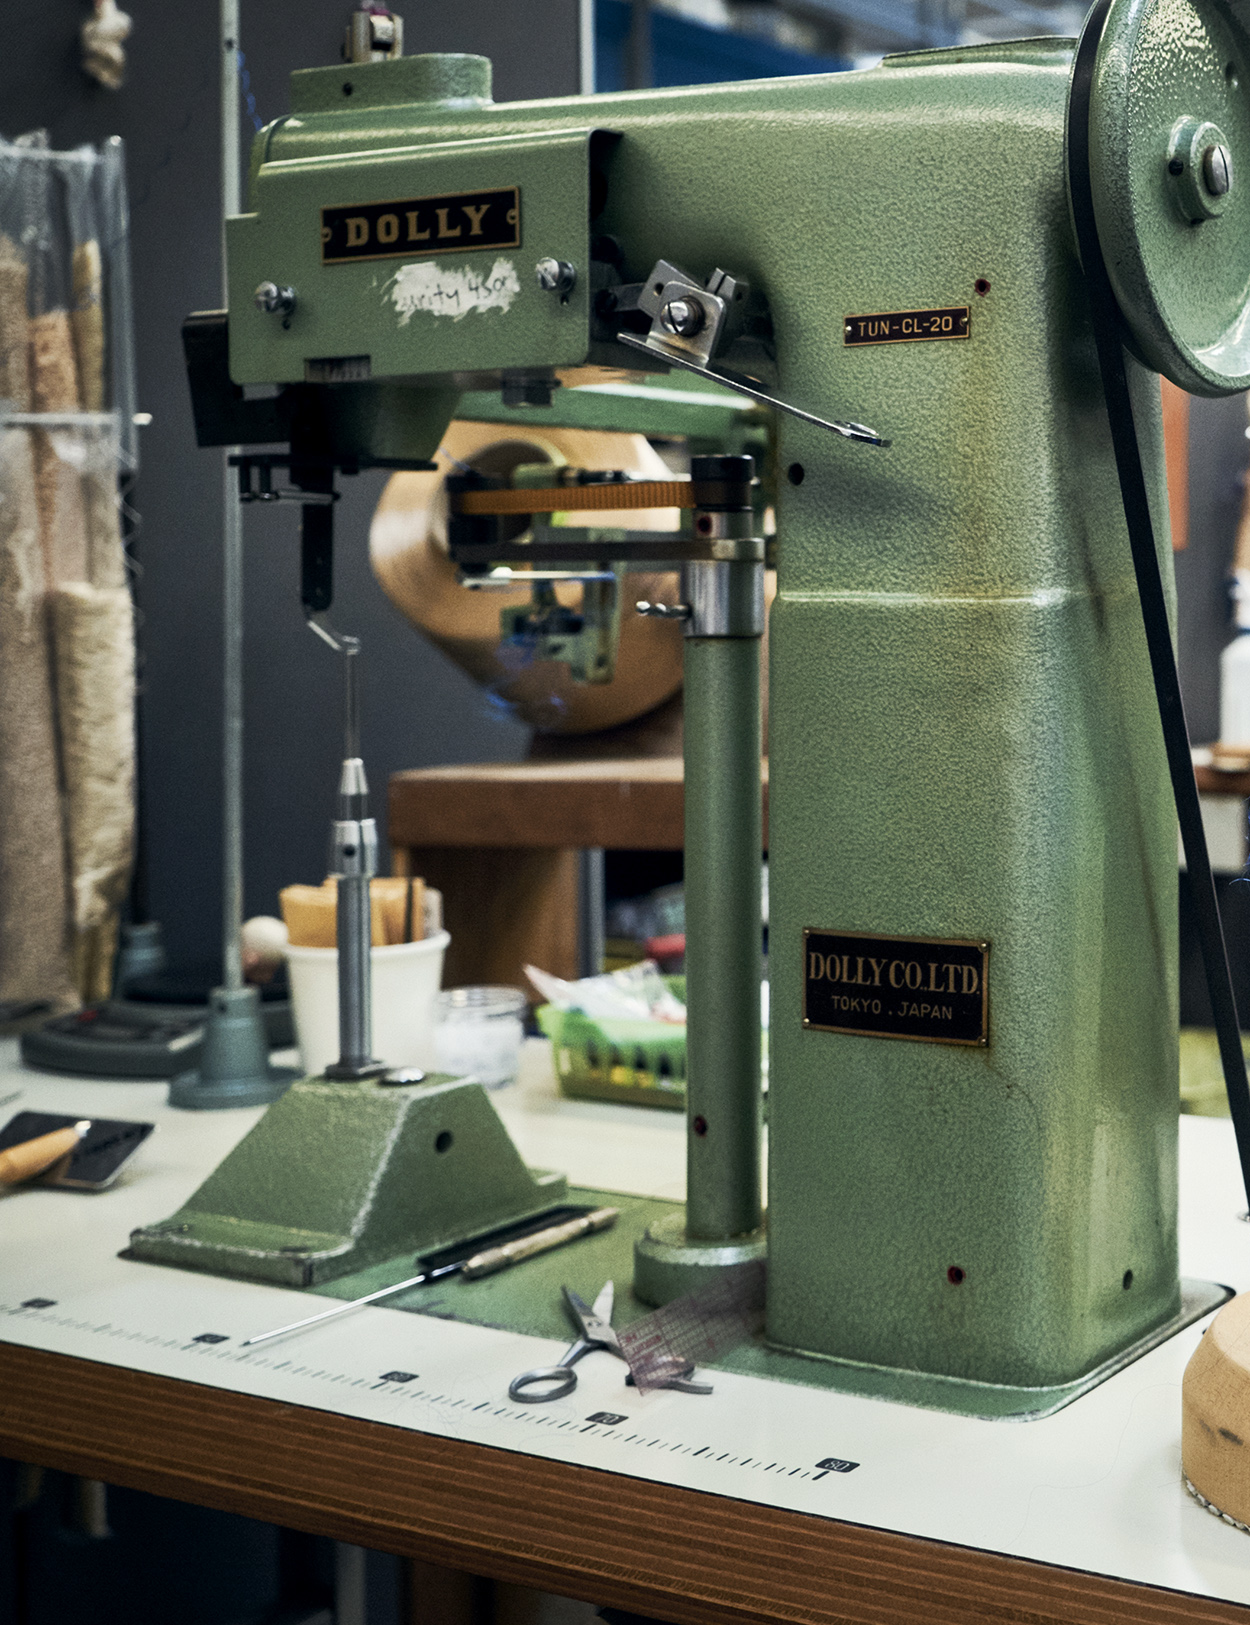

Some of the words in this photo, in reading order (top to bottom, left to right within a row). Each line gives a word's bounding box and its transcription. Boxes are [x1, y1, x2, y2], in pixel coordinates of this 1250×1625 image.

[344, 204, 491, 248] DOLLY
[857, 315, 953, 337] TUN-CL-20
[809, 952, 888, 987] DOLLY
[831, 995, 882, 1015] TOKYO
[897, 1001, 953, 1020] JAPAN
[824, 1460, 850, 1471] 80
